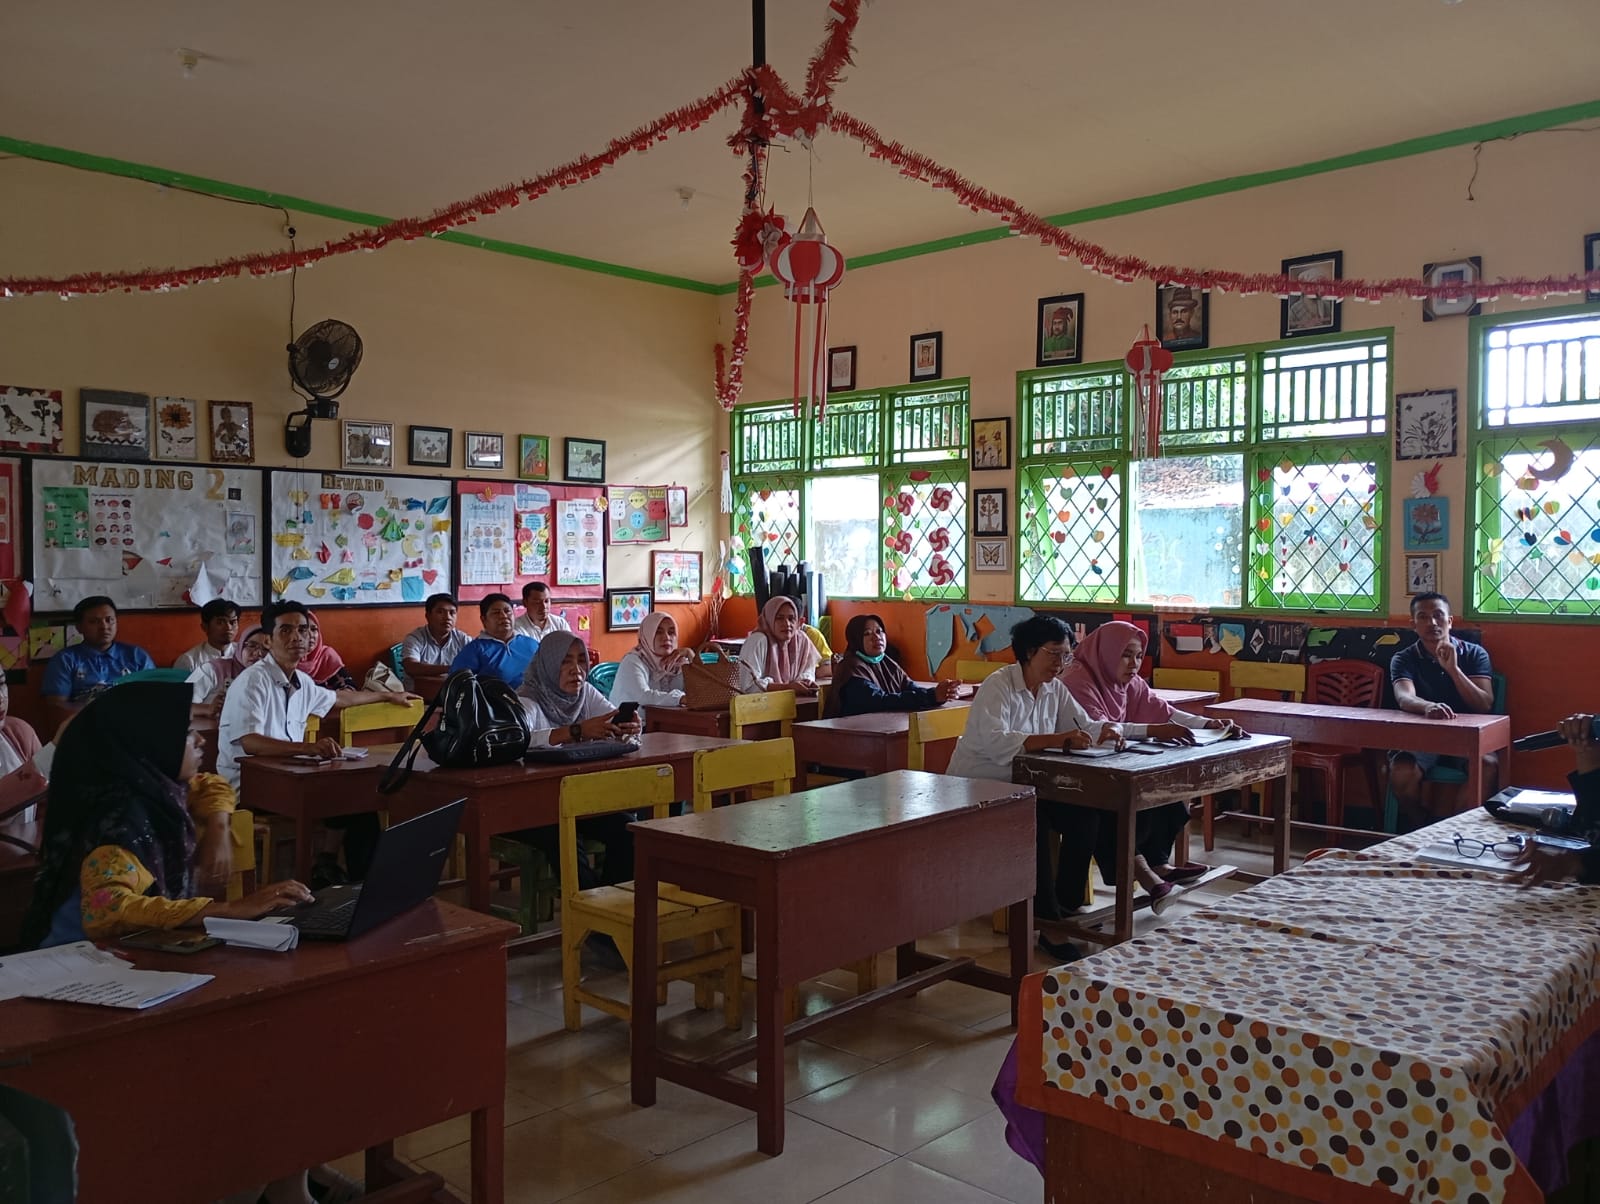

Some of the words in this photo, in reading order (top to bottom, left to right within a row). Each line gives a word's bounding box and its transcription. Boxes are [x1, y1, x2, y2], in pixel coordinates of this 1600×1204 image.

[73, 464, 194, 490] MADING
[204, 468, 225, 501] 2
[323, 474, 384, 492] REWARD
